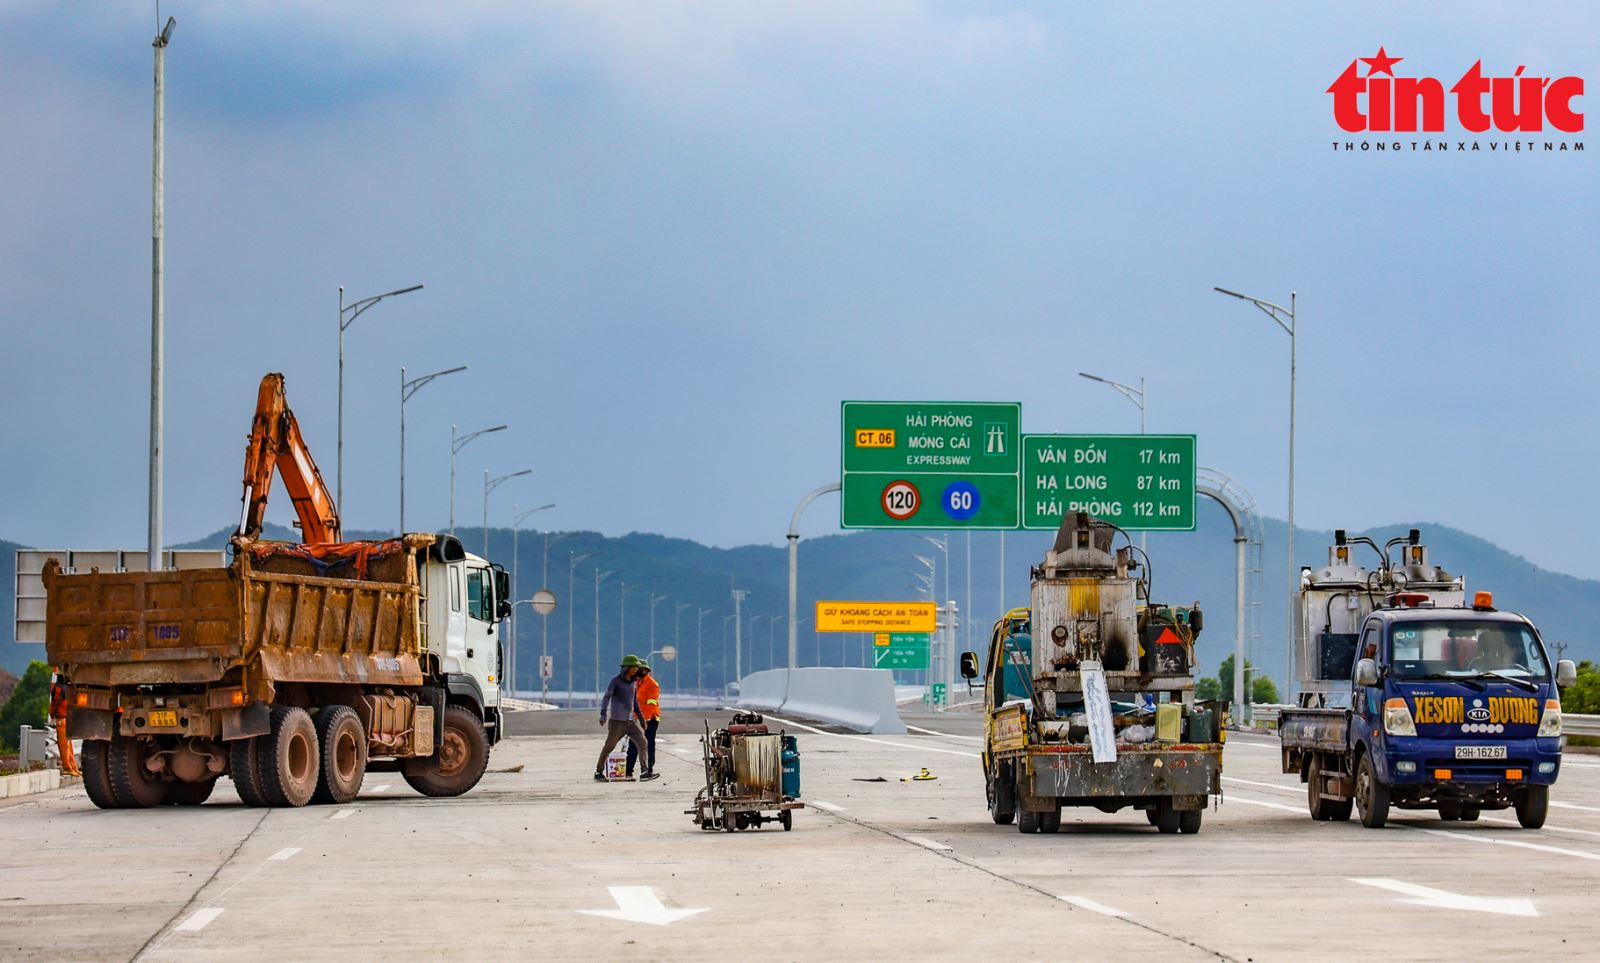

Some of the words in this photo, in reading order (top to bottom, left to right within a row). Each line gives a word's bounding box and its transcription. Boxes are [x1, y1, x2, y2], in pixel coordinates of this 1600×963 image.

[858, 432, 892, 445] CT.06
[908, 433, 944, 449] MÓNG
[950, 433, 971, 449] CÁI
[906, 455, 971, 465] EXPRESSWAY
[1037, 444, 1067, 464] VÂN
[1139, 449, 1153, 464] 17
[1159, 449, 1181, 464] km
[1036, 475, 1058, 493] HẠ
[1065, 475, 1107, 490] LONG
[1137, 475, 1153, 490] 87
[1159, 475, 1181, 490] km
[887, 491, 914, 509] 120
[950, 491, 972, 510] 60
[1036, 497, 1062, 516] HẢI
[1132, 501, 1153, 516] 112
[1159, 501, 1181, 516] km
[1456, 747, 1505, 758] 29H-162.67
